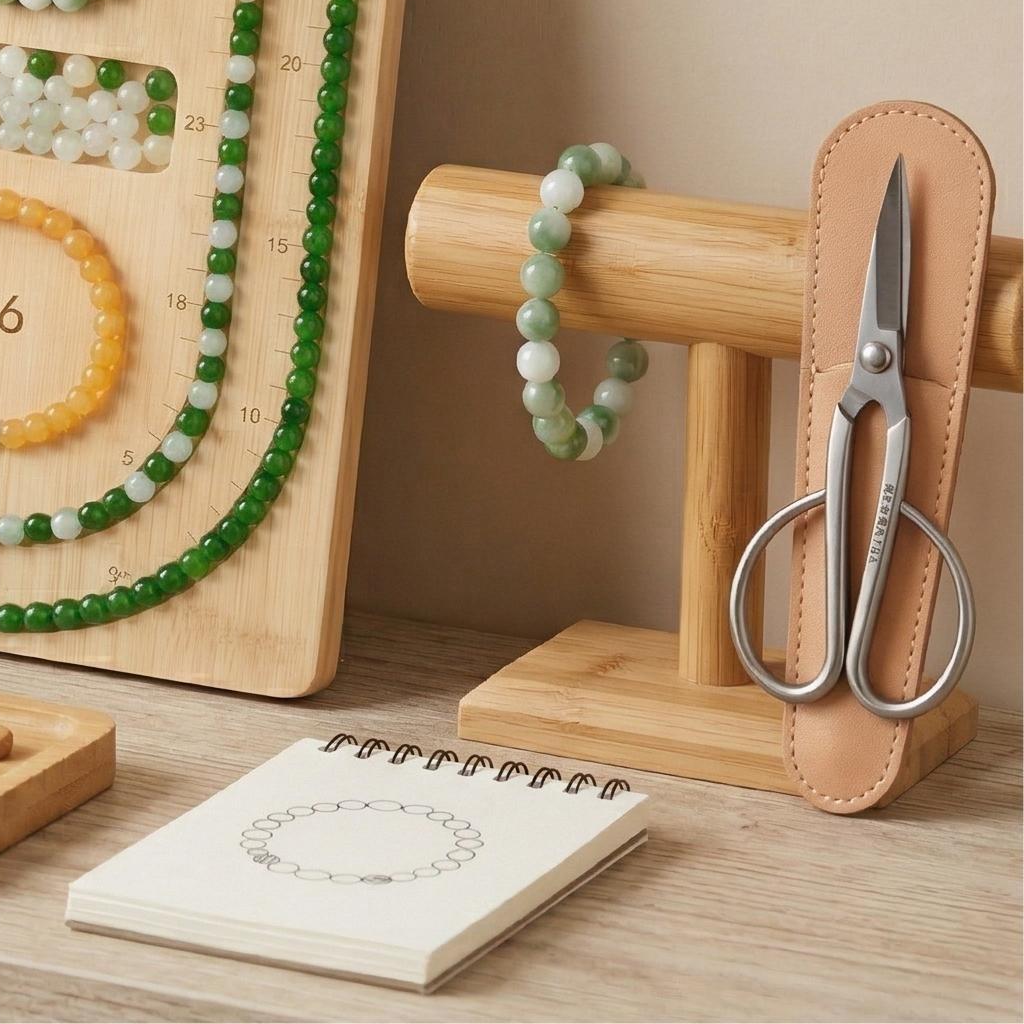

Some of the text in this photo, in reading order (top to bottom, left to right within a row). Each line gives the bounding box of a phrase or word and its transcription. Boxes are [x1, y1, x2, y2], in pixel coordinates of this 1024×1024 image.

[280, 56, 302, 72] 20
[184, 115, 205, 132] 23
[268, 237, 289, 254] 15
[166, 293, 187, 311] 18
[240, 407, 261, 424] 10
[121, 450, 134, 466] 5
